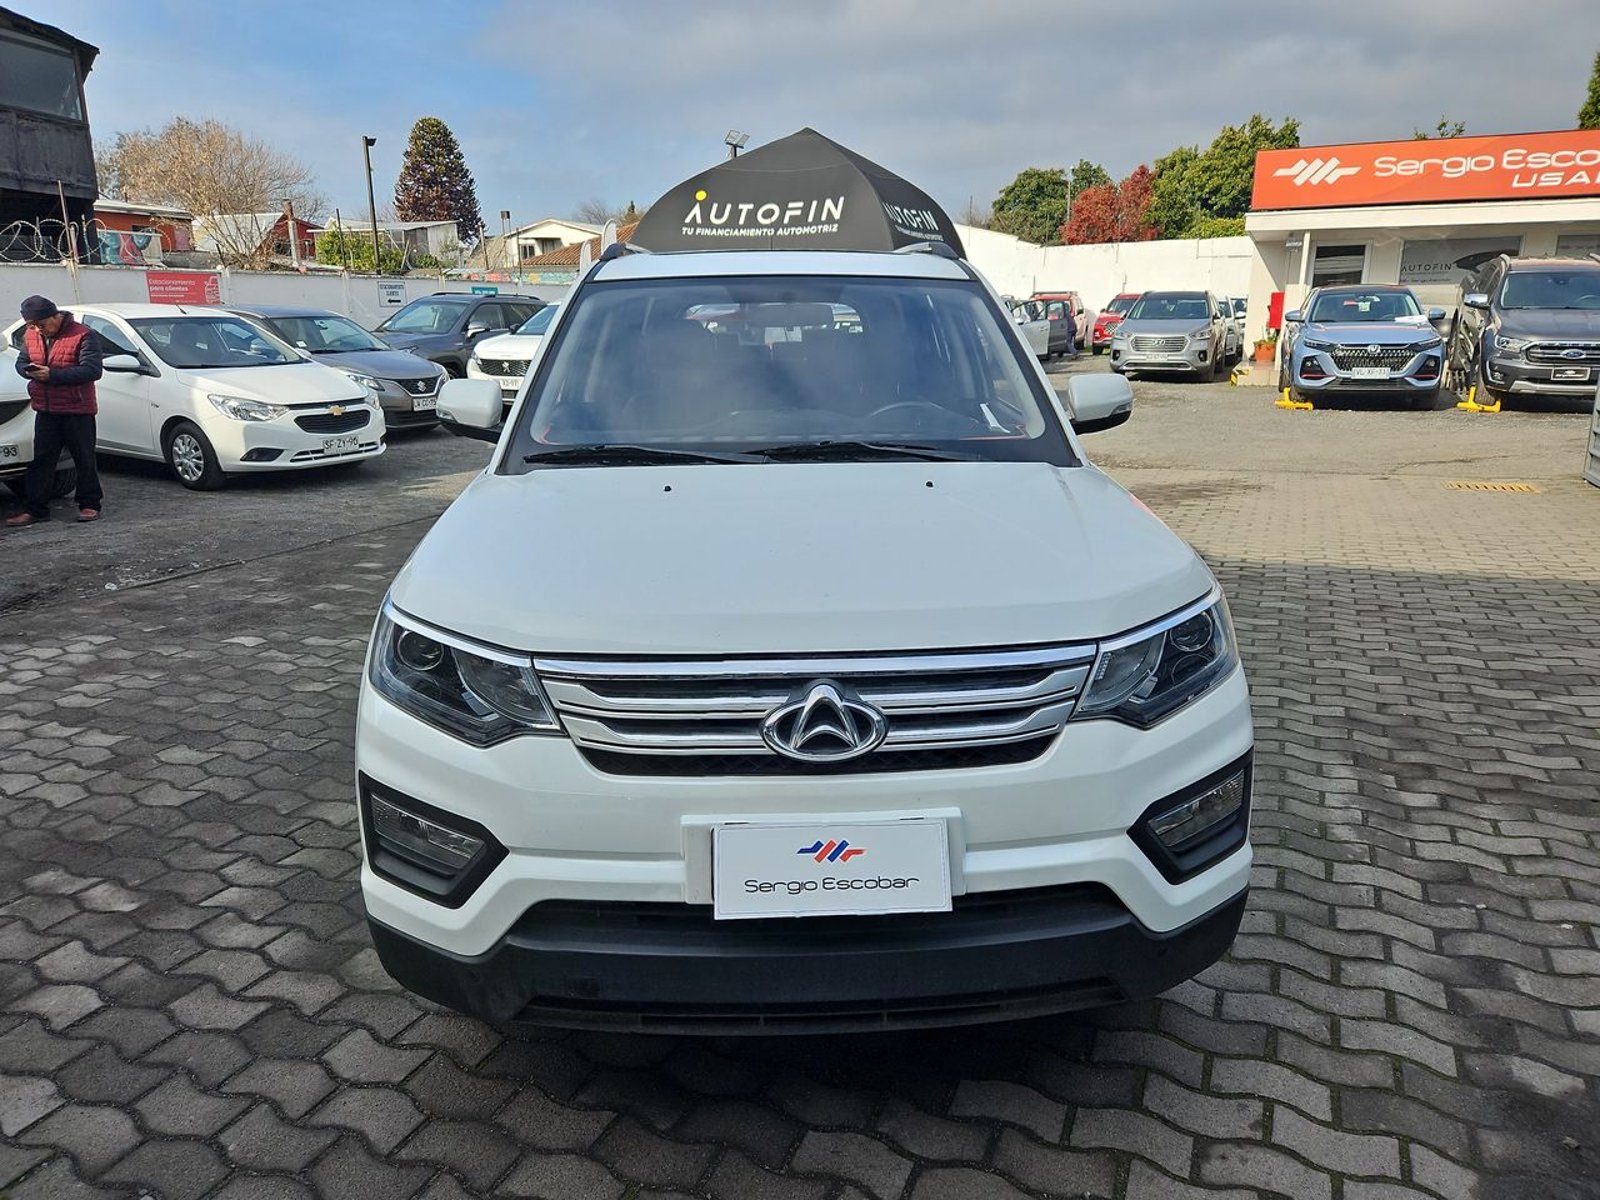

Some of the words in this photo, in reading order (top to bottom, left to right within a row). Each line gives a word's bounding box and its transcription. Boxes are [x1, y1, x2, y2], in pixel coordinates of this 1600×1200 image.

[1374, 154, 1496, 178] Sergio
[684, 194, 845, 225] AUTOFIN
[682, 227, 694, 236] TU
[695, 228, 775, 237] FINANCIAMIENTO
[777, 224, 839, 236] AUTOMOTRIZ
[744, 879, 818, 895] Sergio
[821, 876, 920, 891] Escobar
